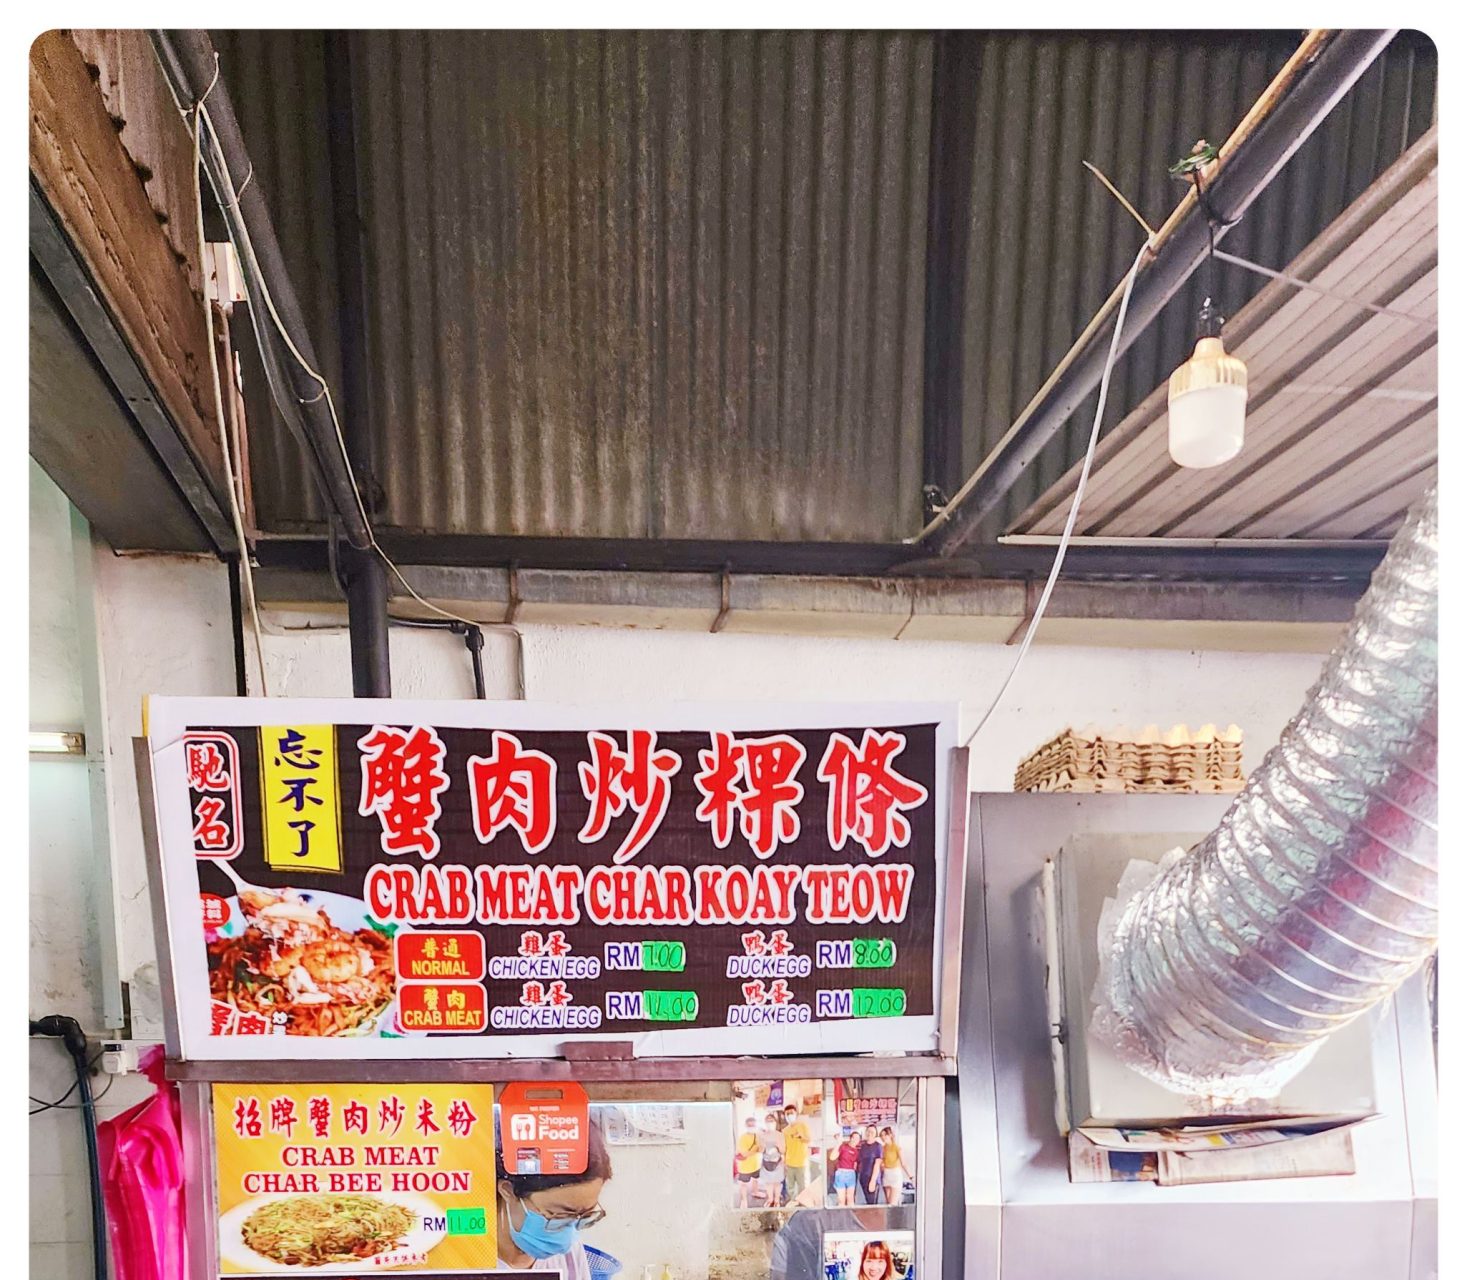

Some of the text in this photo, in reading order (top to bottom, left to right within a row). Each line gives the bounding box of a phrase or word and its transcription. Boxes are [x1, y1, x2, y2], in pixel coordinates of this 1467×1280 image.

[187, 744, 231, 848] 馳名
[274, 728, 324, 858] 忘不了
[360, 727, 927, 858] 蟹肉炒粿條
[366, 865, 912, 925] CRAB MEAT CHAR KOAY TEOW
[421, 937, 462, 959] 普通
[411, 960, 470, 976] NORMAL
[491, 958, 599, 976] CHICKEN EGG
[729, 956, 810, 976] DUCK EGG
[423, 988, 467, 1011] 蟹肉
[403, 1010, 482, 1026] CRAB MEAT
[493, 1008, 600, 1026] CHICKEN EGG
[729, 1006, 809, 1025] DUCK EGG
[233, 1096, 478, 1138] 招牌蟹肉炒米粉
[538, 1113, 579, 1127] Shopee
[538, 1125, 580, 1140] Food
[281, 1146, 440, 1167] CRAB MEAT
[243, 1171, 471, 1194] CHAR BEE HOON
